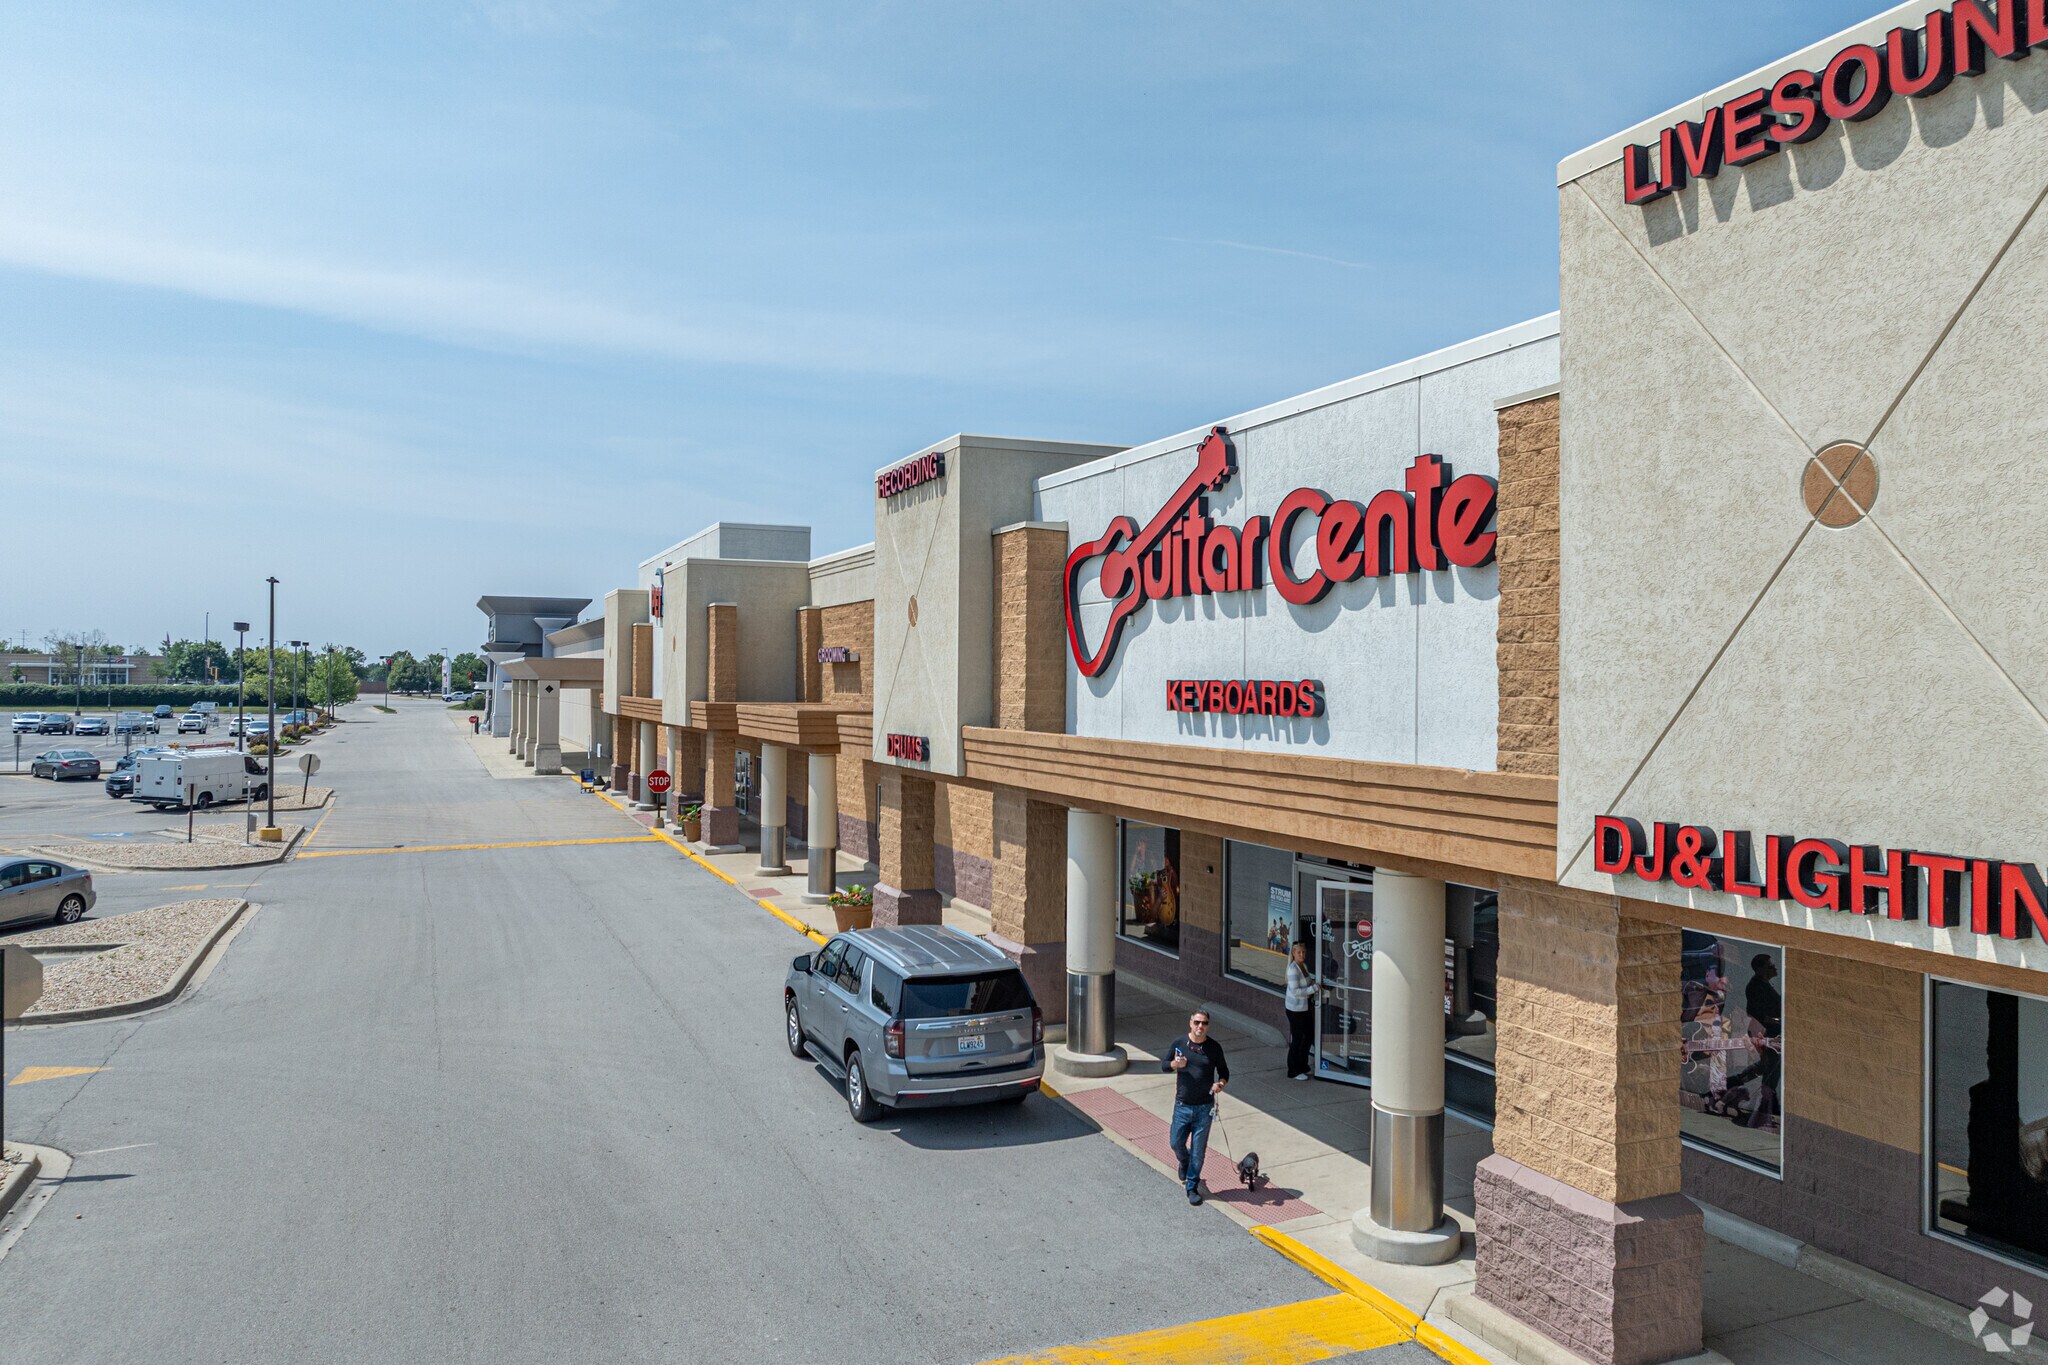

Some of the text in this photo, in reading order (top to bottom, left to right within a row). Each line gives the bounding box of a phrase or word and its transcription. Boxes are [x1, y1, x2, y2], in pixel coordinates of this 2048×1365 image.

[1624, 0, 2048, 205] LIVESOUN
[878, 452, 941, 498] RECORDING
[1064, 426, 1271, 677] Guitar
[817, 646, 846, 663] GROOMING
[1167, 679, 1320, 718] KEYBOARDS
[887, 733, 926, 762] DRUMS
[648, 776, 670, 786] STOP
[1270, 886, 1292, 898] STRUM
